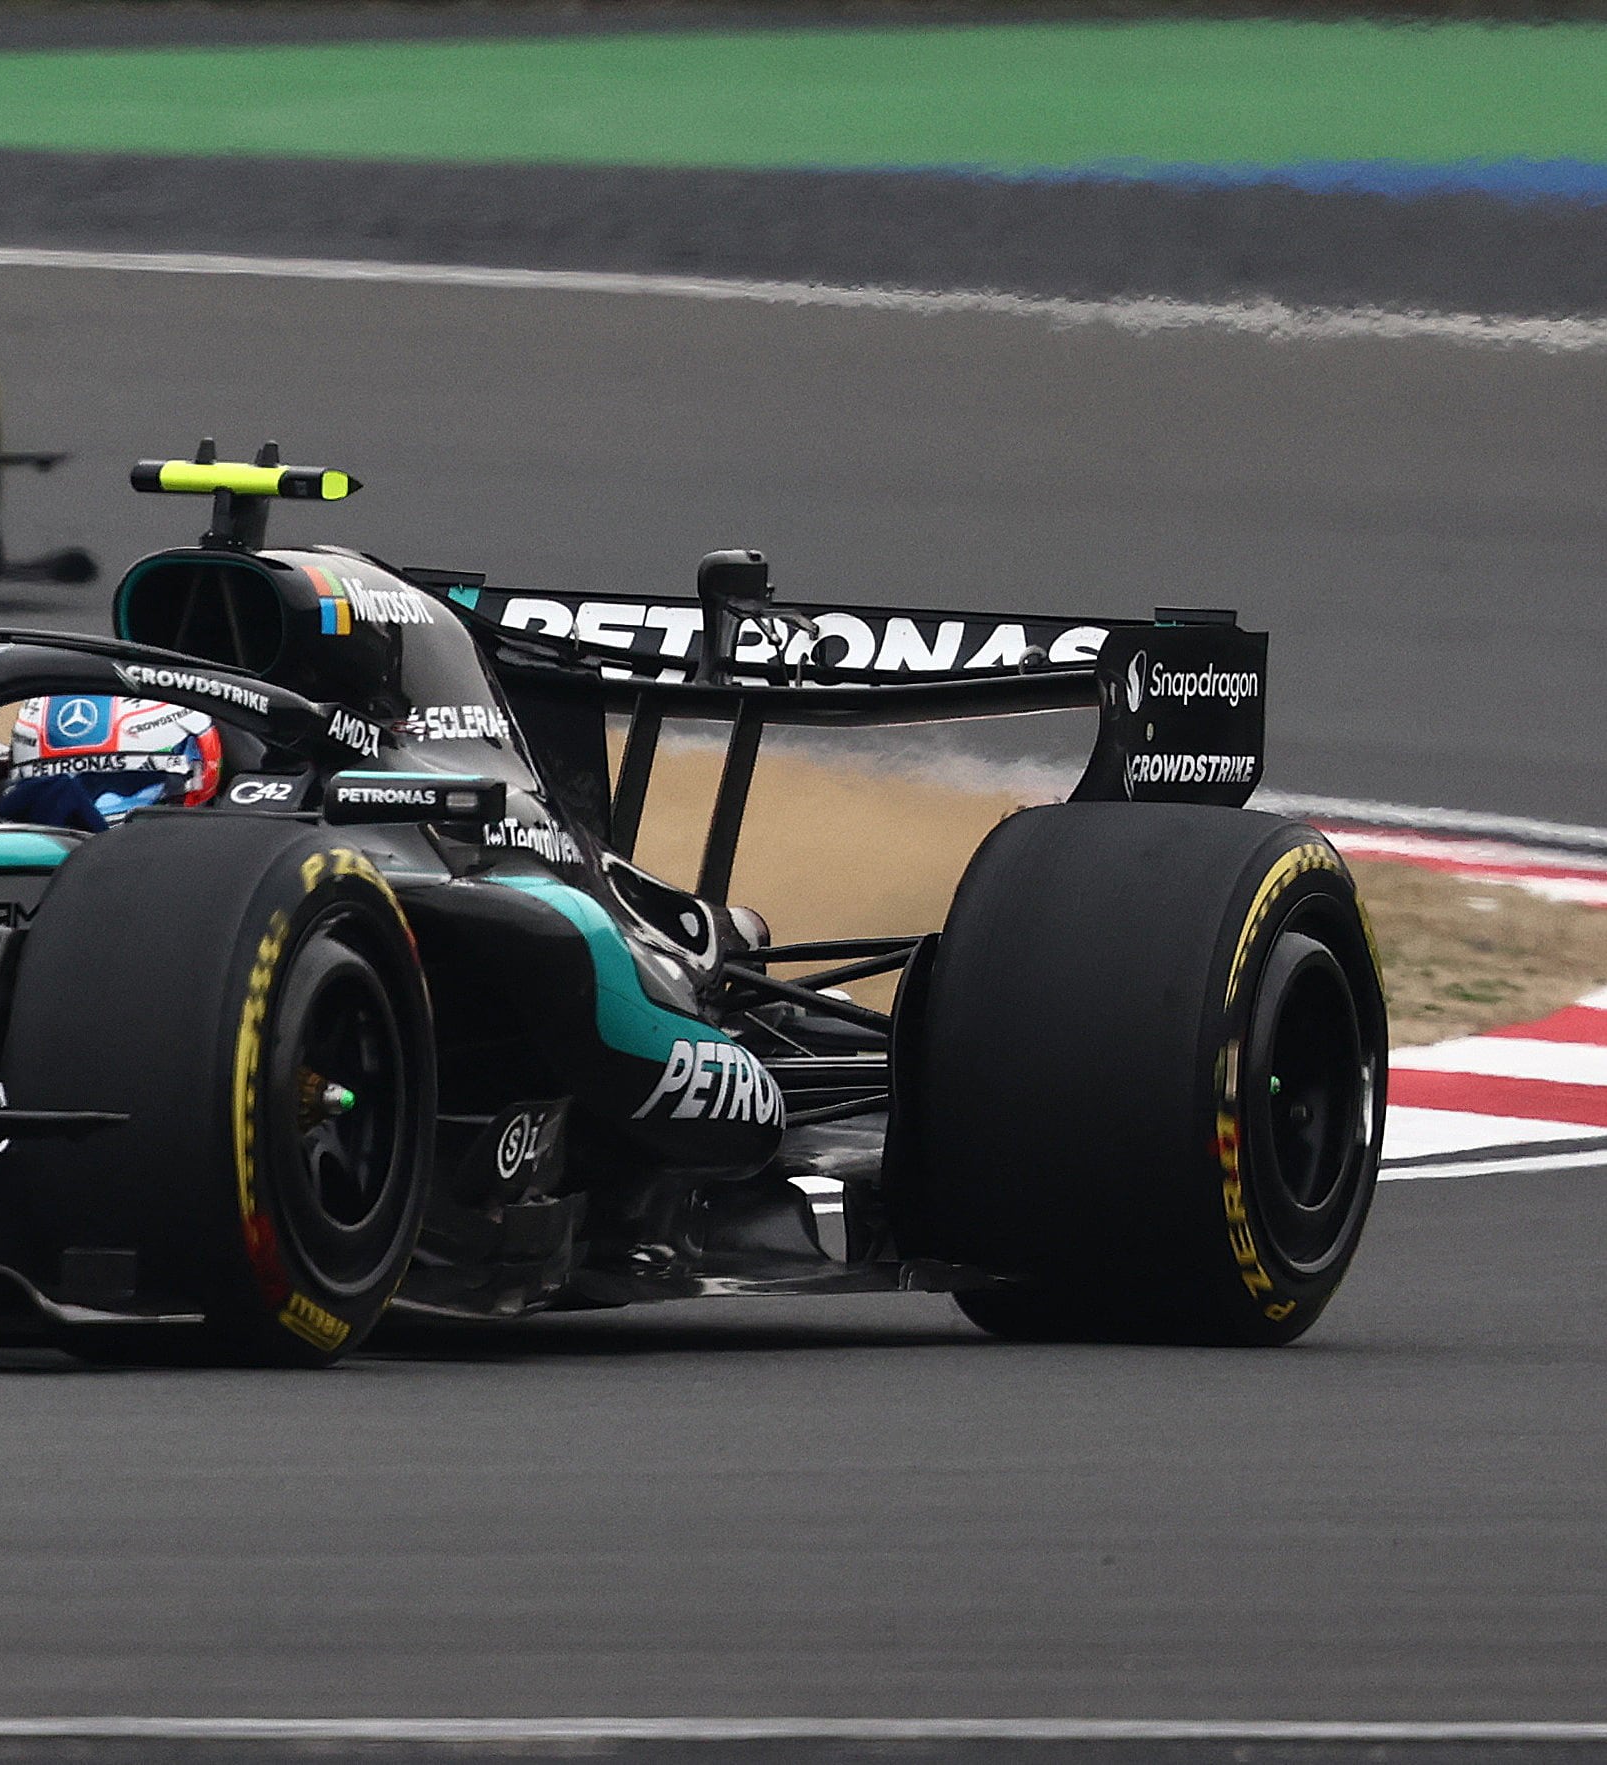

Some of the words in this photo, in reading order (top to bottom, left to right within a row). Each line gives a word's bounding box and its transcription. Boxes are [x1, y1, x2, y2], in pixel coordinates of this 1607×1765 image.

[342, 578, 434, 624] Microsoft
[125, 665, 269, 714] CROWDSTRIKE
[1150, 662, 1258, 707] Snapdragon
[328, 709, 366, 749] AMD
[425, 705, 504, 739] SOLERA
[1131, 754, 1255, 783] CROWDSTRIKE
[230, 781, 292, 804] G42
[337, 788, 437, 805] PETRONAS
